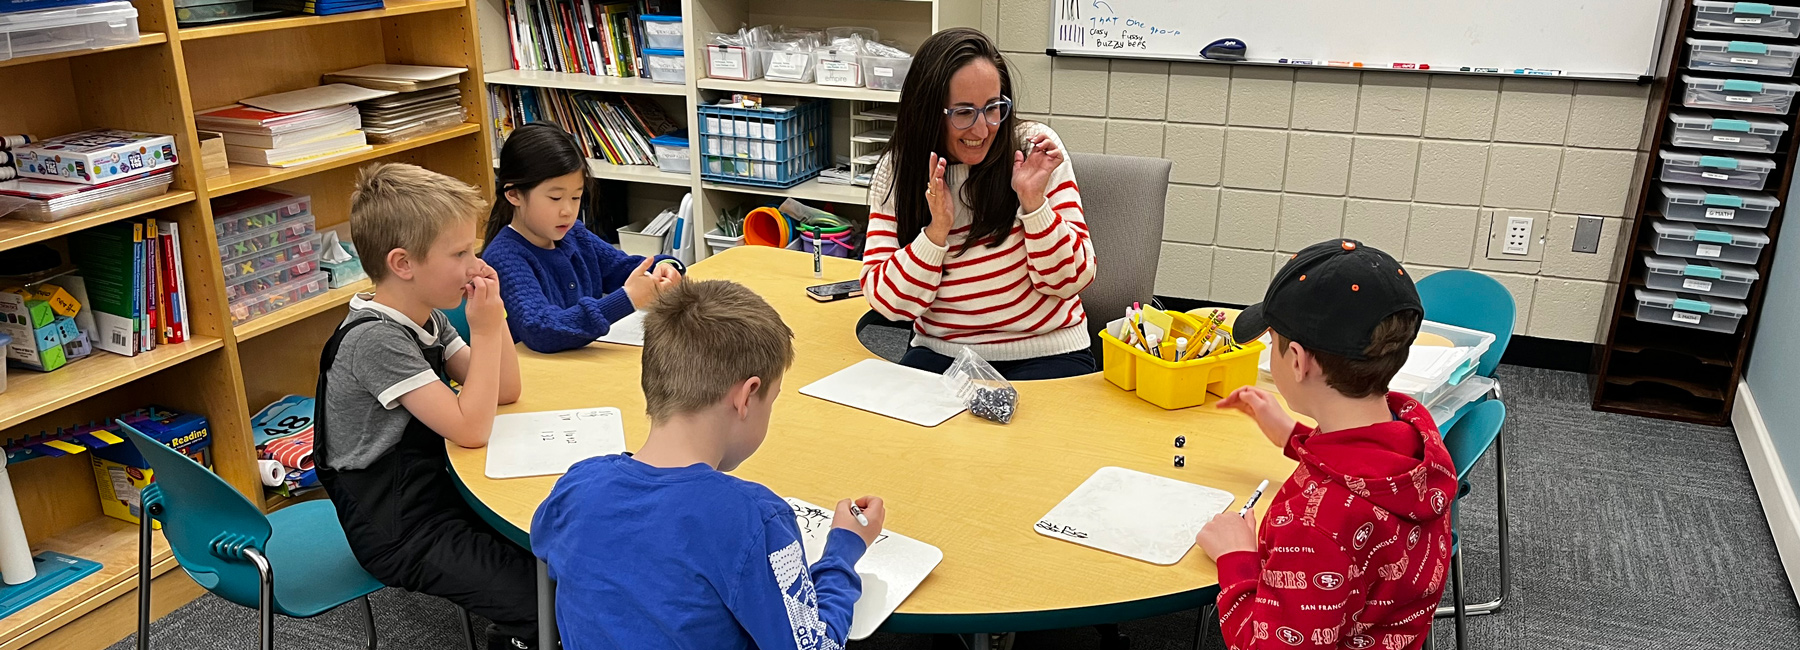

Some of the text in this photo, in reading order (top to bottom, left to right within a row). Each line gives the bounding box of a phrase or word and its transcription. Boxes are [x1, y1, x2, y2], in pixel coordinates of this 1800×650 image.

[171, 428, 208, 447] Reading
[1344, 494, 1356, 508] SAN
[1301, 546, 1316, 554] FTBL
[1267, 599, 1280, 607] FTBL
